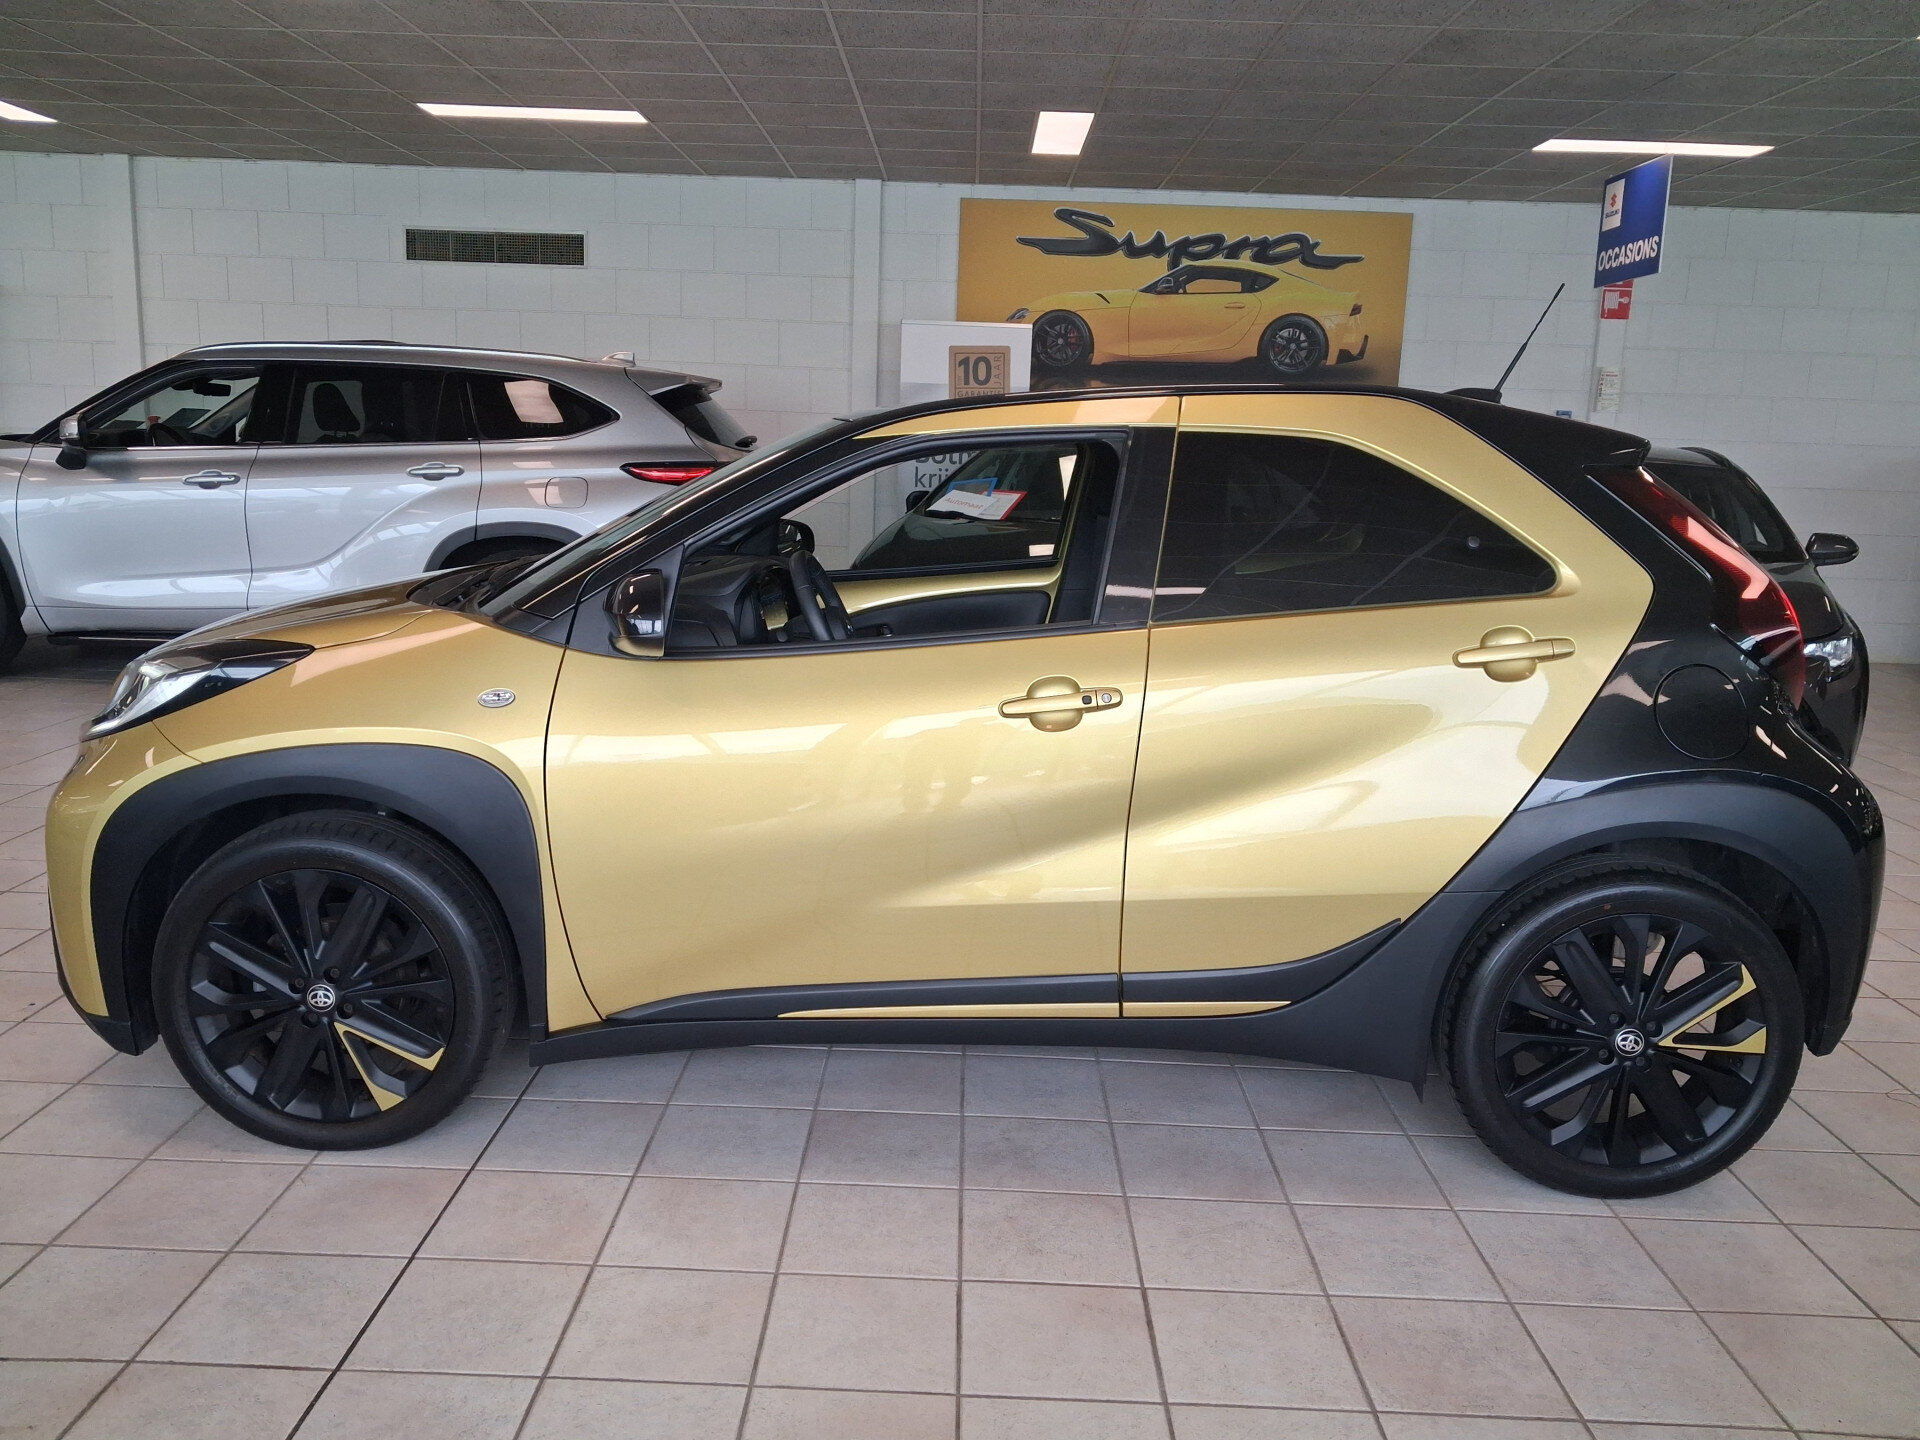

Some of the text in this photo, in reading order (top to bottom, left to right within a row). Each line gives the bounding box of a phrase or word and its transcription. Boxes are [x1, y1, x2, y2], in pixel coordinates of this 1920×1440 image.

[1015, 207, 1365, 270] Supra
[1598, 235, 1660, 272] OCCASIONS
[957, 355, 992, 386] 10
[993, 355, 1003, 386] JAAR
